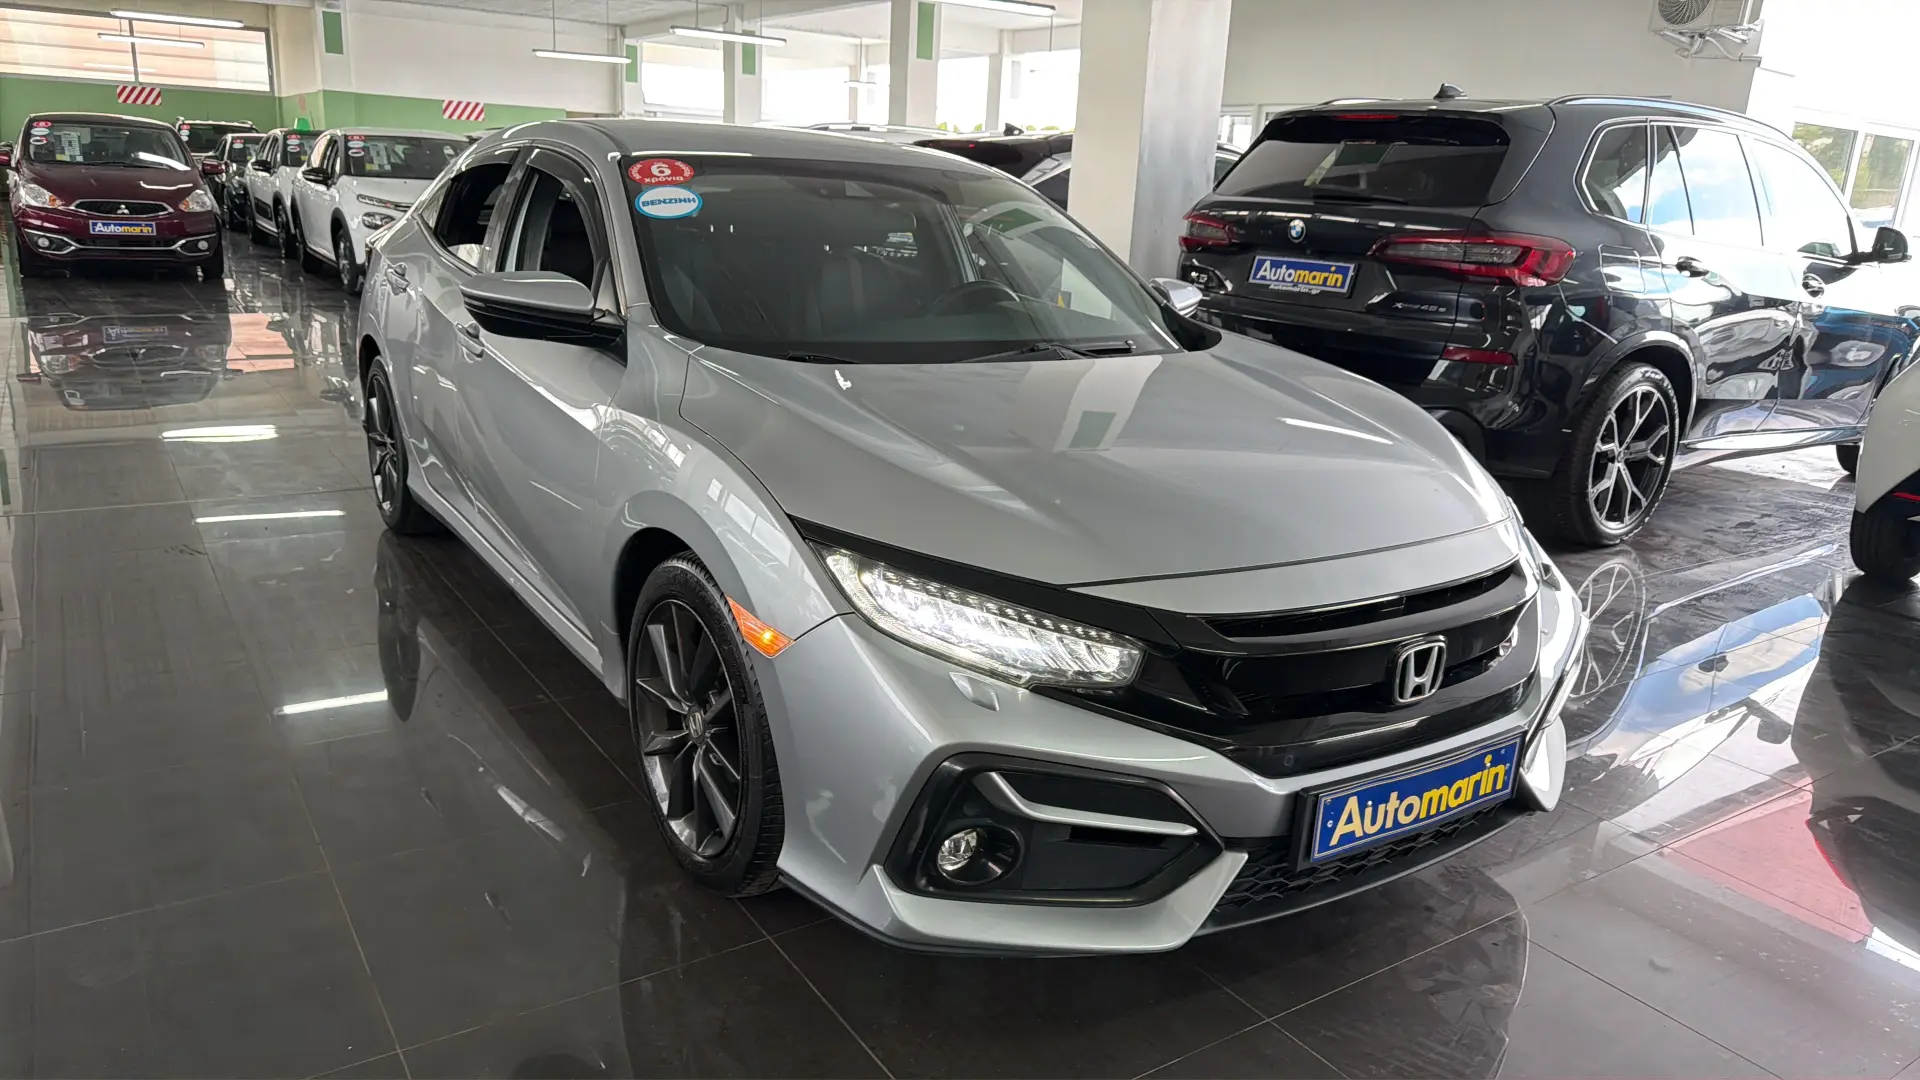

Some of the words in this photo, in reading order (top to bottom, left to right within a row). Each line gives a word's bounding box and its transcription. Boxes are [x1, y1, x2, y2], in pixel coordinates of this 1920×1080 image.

[650, 163, 672, 176] 6
[641, 197, 697, 207] ΒΕΝΖΙΝΗ
[94, 222, 152, 234] Automarin
[1256, 260, 1343, 287] Automarin
[1269, 284, 1321, 295] Automarin.gr
[1328, 753, 1507, 847] Automarin
